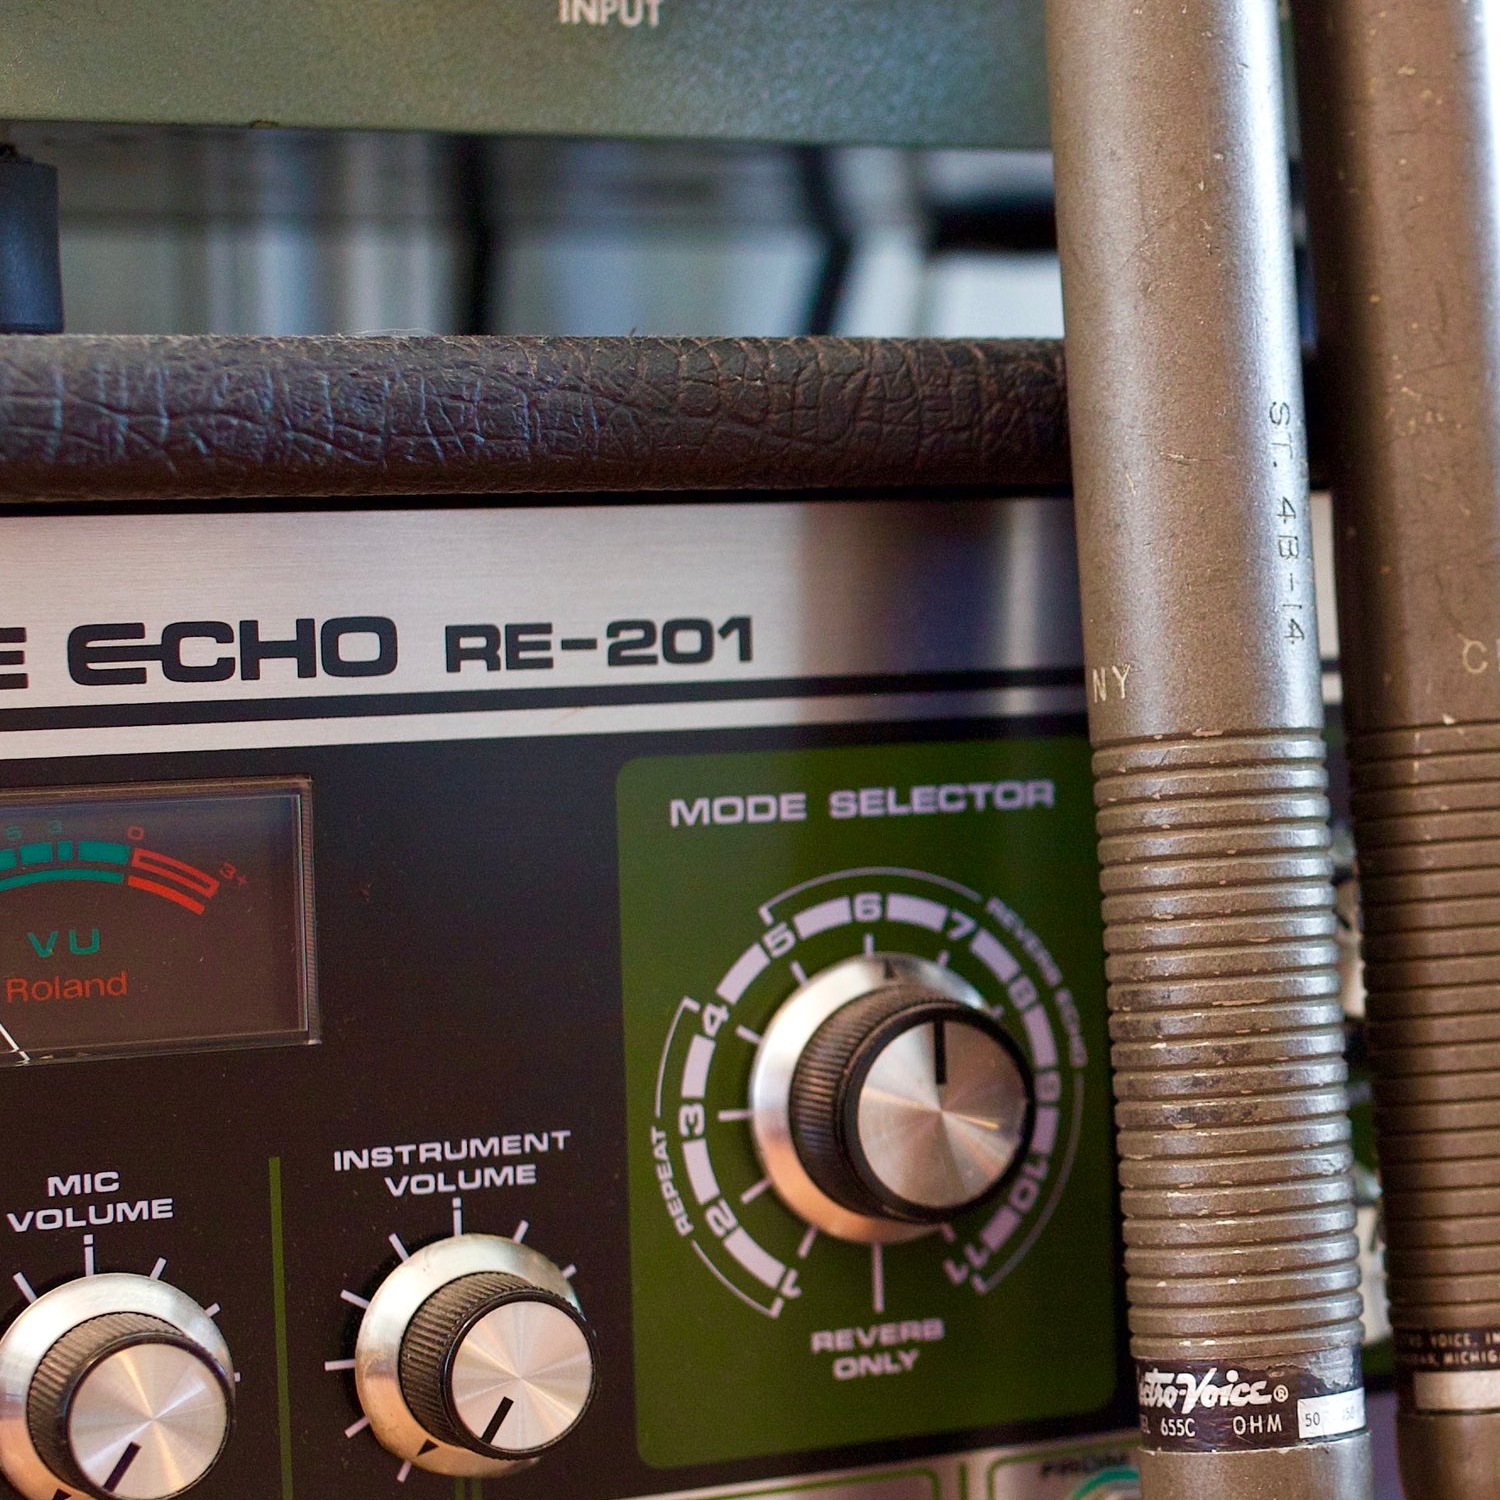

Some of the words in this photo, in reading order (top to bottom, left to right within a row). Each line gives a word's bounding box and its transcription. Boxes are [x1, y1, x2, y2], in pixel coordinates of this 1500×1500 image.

[67, 615, 398, 687] ECHO
[444, 615, 754, 675] RE-201
[1091, 663, 1132, 703] NY
[669, 793, 807, 828] MODE
[829, 780, 1056, 819] SELECTOR
[853, 892, 882, 923] 6
[763, 922, 797, 959] 5
[947, 910, 977, 942] 7
[5, 970, 128, 1004] Roland
[703, 1002, 729, 1038] 4
[678, 1103, 705, 1138] 3
[333, 1130, 572, 1172] INSTRUMENT
[47, 1171, 121, 1197] MIC
[384, 1164, 537, 1199] VOLUME
[650, 1125, 694, 1237] REPEAT
[7, 1198, 174, 1233] VOLUME
[705, 1199, 740, 1238] 2
[781, 1268, 802, 1299] 1
[811, 1318, 945, 1354] REVERB
[832, 1348, 920, 1381] ONLY
[1160, 1417, 1196, 1438] 655C
[1232, 1413, 1283, 1436] OHM
[1304, 1411, 1321, 1428] 50
